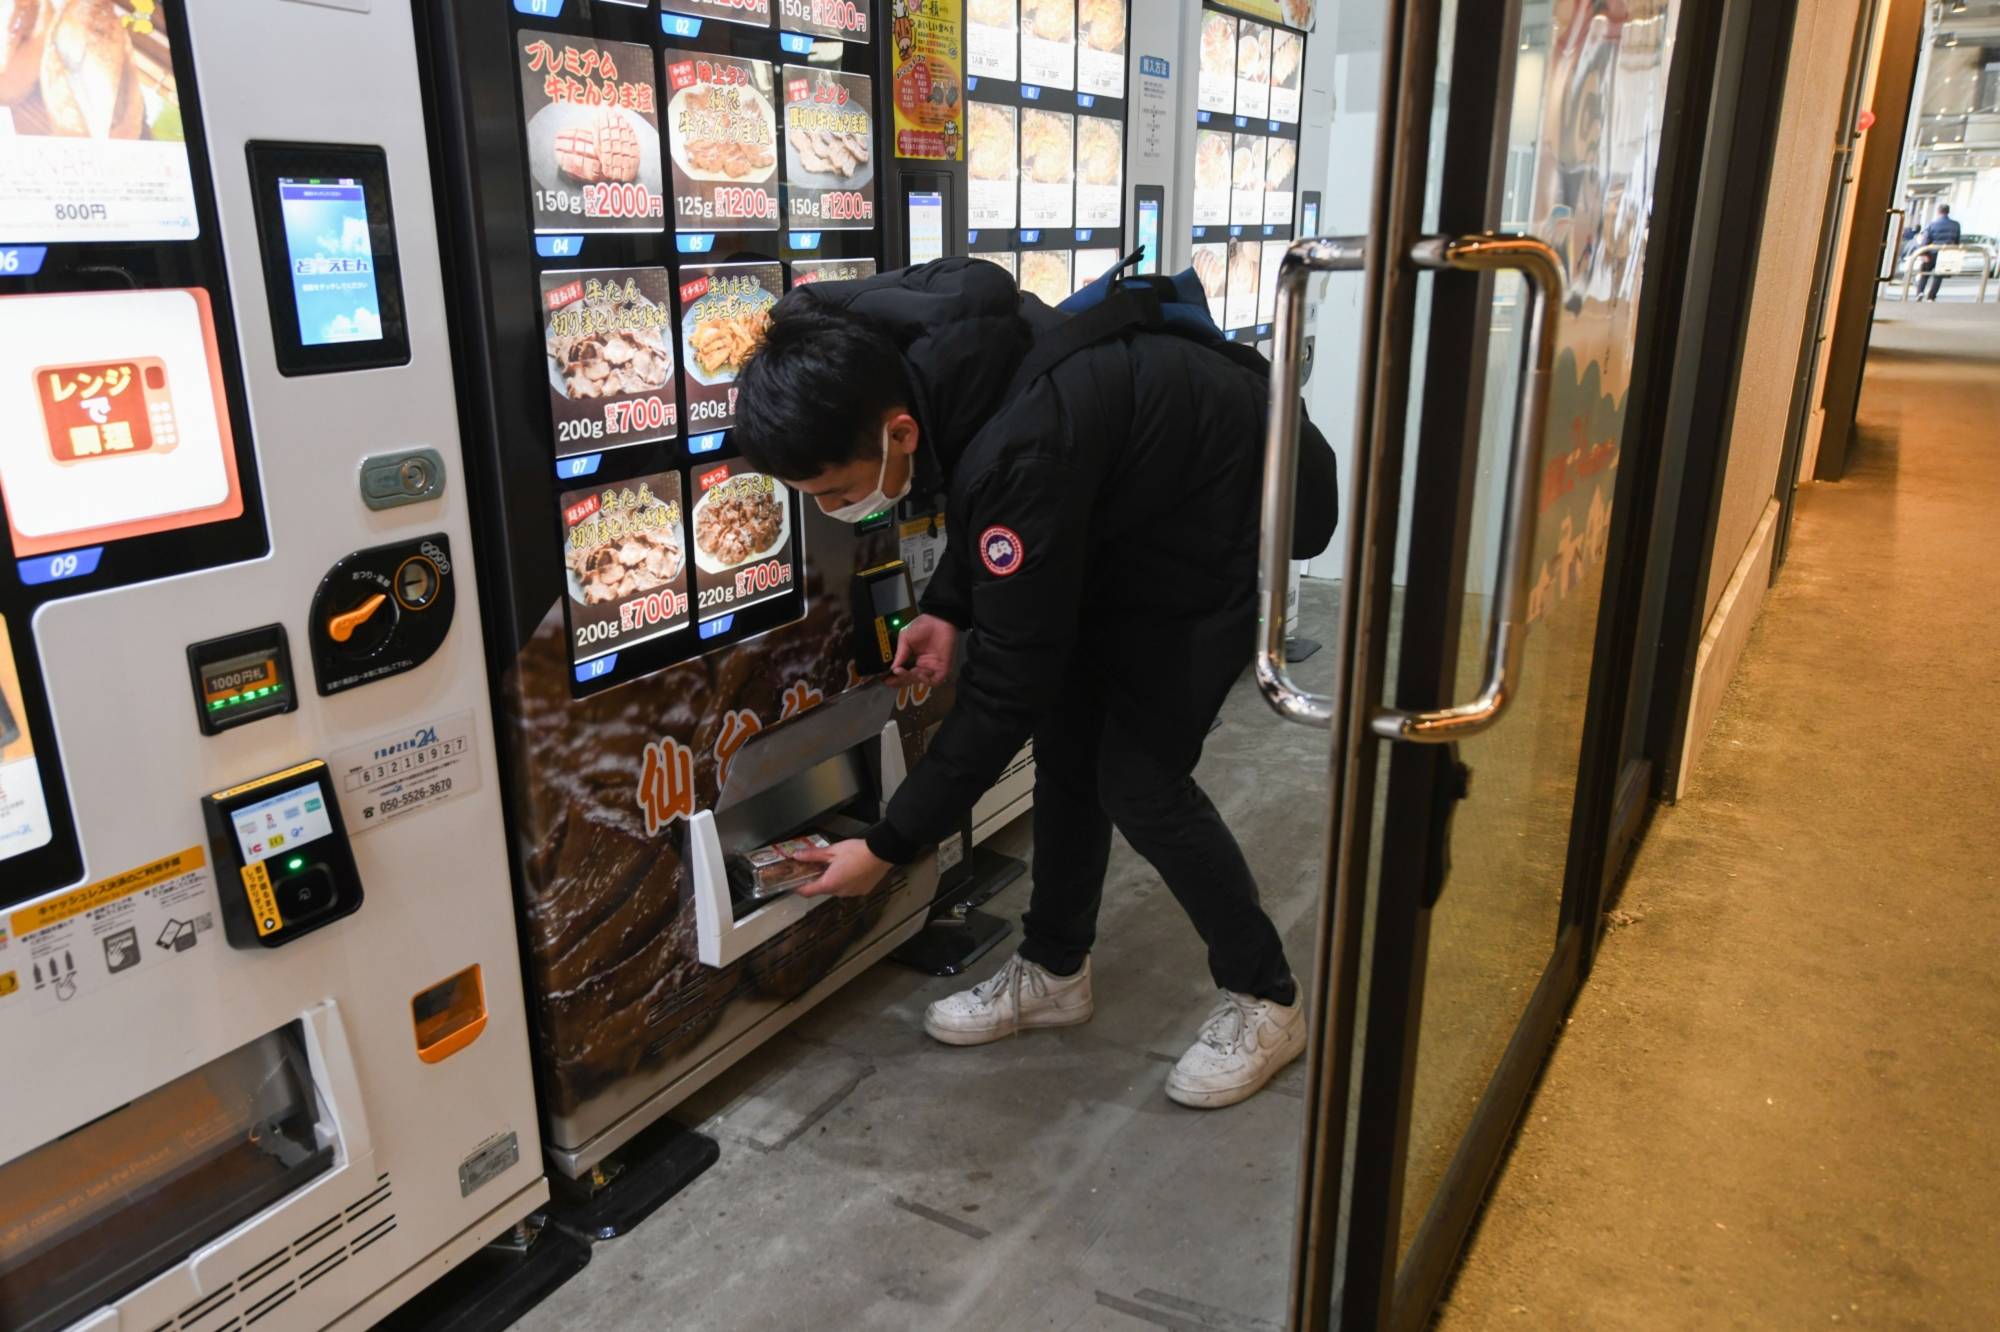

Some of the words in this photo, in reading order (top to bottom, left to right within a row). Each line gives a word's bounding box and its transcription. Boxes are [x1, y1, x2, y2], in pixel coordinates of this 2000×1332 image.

[676, 20, 689, 34] 02
[792, 36, 803, 49] 03
[525, 40, 618, 80] プレミアム
[544, 74, 654, 112] 牛たんうま塩
[814, 84, 850, 105] 上タン
[679, 110, 770, 145] 牛たんうま塩
[789, 106, 868, 135] 厚切り牛たんうま塩
[55, 203, 107, 220] 800円
[536, 190, 582, 214] 150g
[678, 196, 712, 218] 125g
[790, 198, 820, 217] 150g
[553, 239, 568, 254] 04
[690, 236, 703, 250] 05
[296, 254, 369, 274] どえもん
[586, 278, 641, 305] 牛たん
[708, 275, 761, 296] 牛ホルモン
[552, 302, 669, 337] 切り落としねぎ塩味
[50, 366, 131, 402] レンジ
[80, 396, 112, 424] で
[690, 400, 726, 421] 260g
[558, 418, 604, 442] 200g
[572, 459, 587, 475] 07
[602, 482, 654, 513] 牛たん
[570, 500, 680, 549] 切り落としねぎ塩味
[51, 555, 77, 576] 09
[698, 586, 735, 610] 220g
[576, 620, 619, 648] 200g
[712, 620, 722, 634] 11
[212, 667, 265, 692] 1000円札
[591, 660, 604, 676] 10
[380, 778, 452, 815] 050-5526-3670
